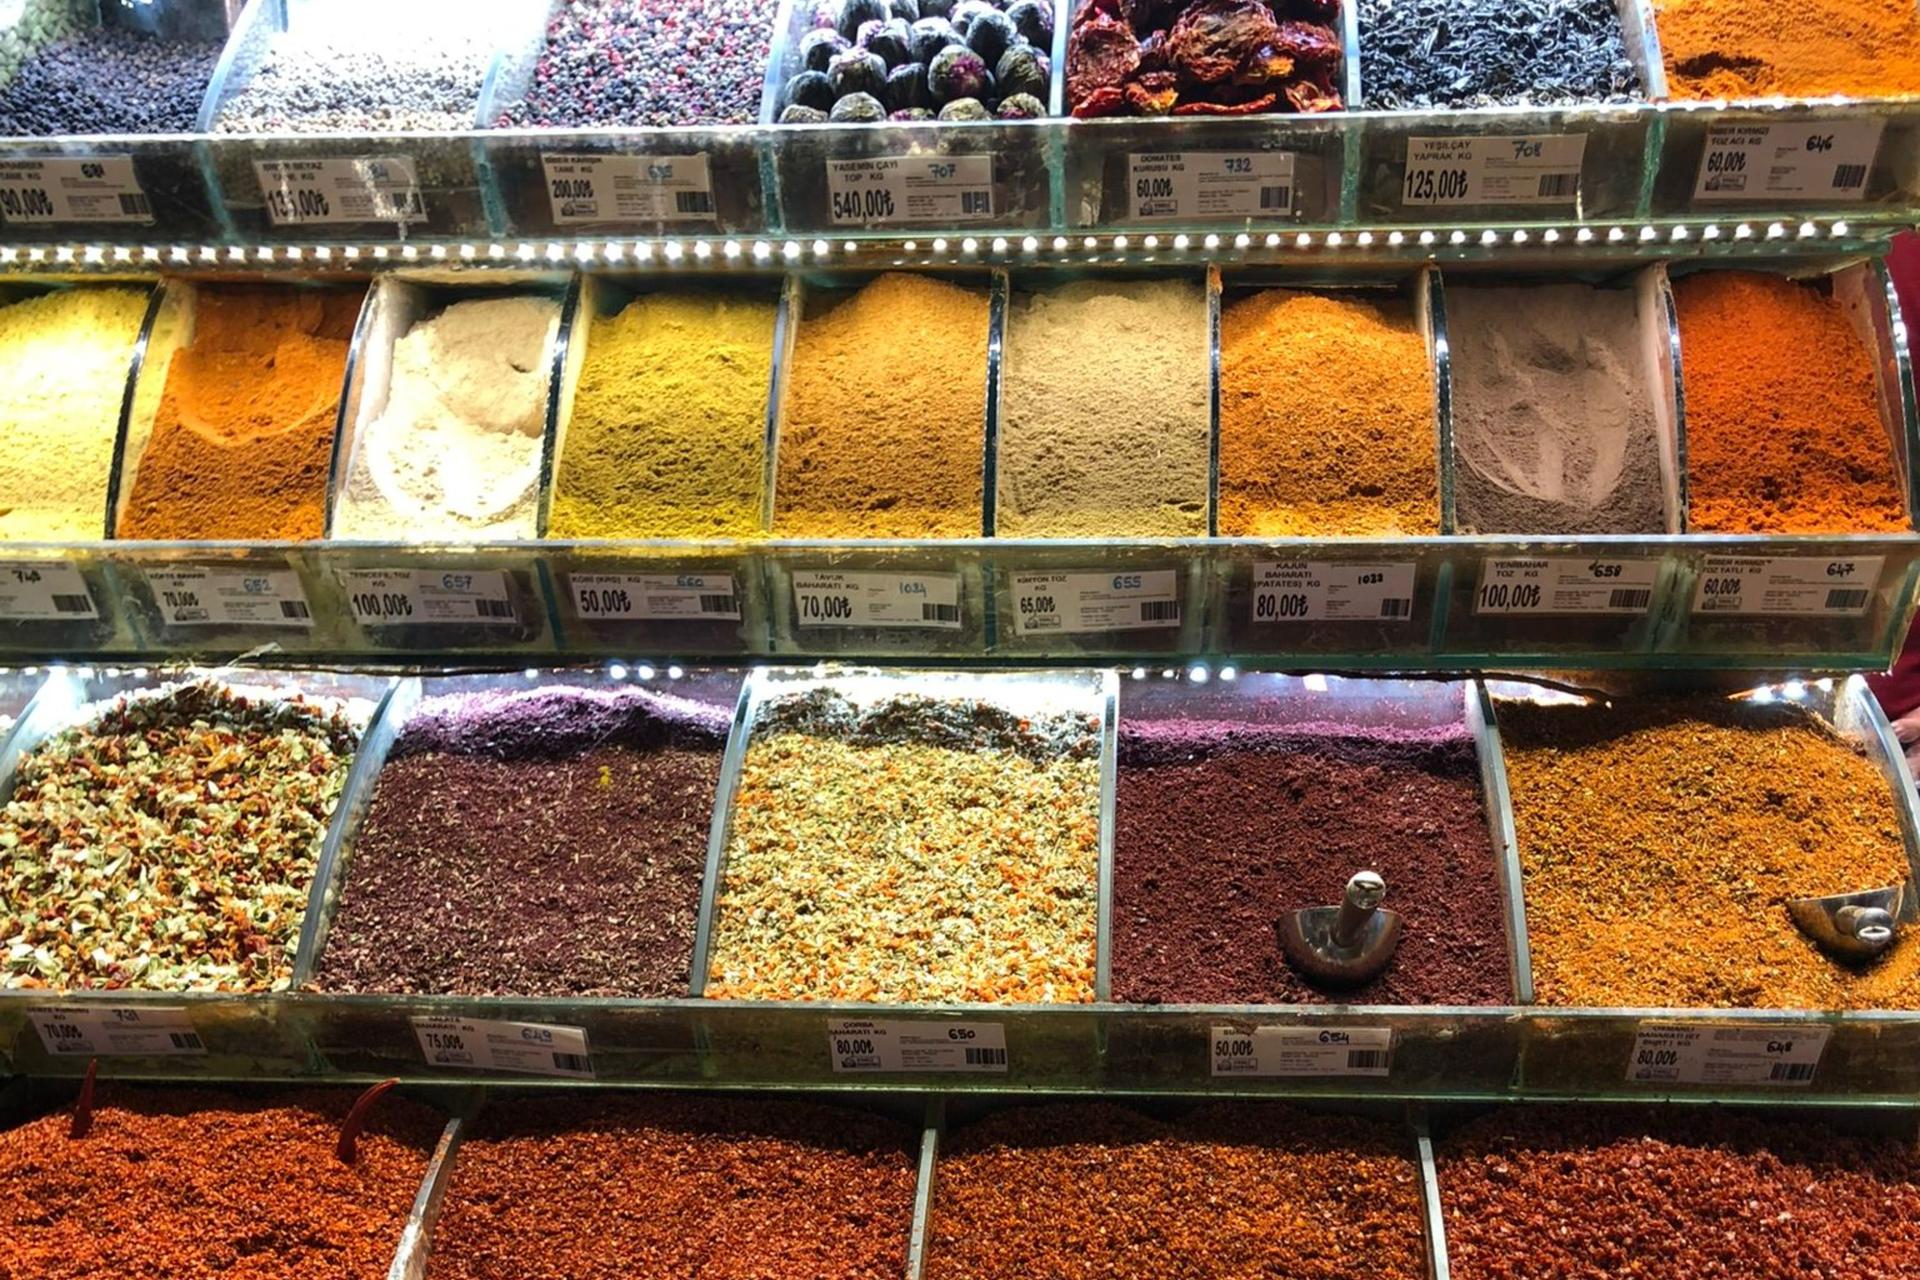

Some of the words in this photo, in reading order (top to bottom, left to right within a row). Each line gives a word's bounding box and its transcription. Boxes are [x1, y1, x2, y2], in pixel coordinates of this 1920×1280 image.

[928, 164, 956, 178] 707
[1707, 151, 1746, 176] 60,00₺
[844, 174, 862, 182] TOP
[870, 173, 883, 181] KG
[1137, 178, 1173, 201] 60,00₺
[1406, 169, 1468, 203] 125,00₺
[833, 189, 894, 221] 540,00₺
[1480, 584, 1540, 611] 100,00₺
[1704, 578, 1741, 597] 60,00₺
[352, 594, 412, 619] 100,00₺
[581, 590, 631, 616] 50,00₺
[801, 596, 851, 621] 70,00₺
[1021, 596, 1056, 617] 65,00₺
[1257, 594, 1308, 622] 80,00₺
[948, 1028, 976, 1040] 650
[1216, 1040, 1253, 1059] 50,00₺
